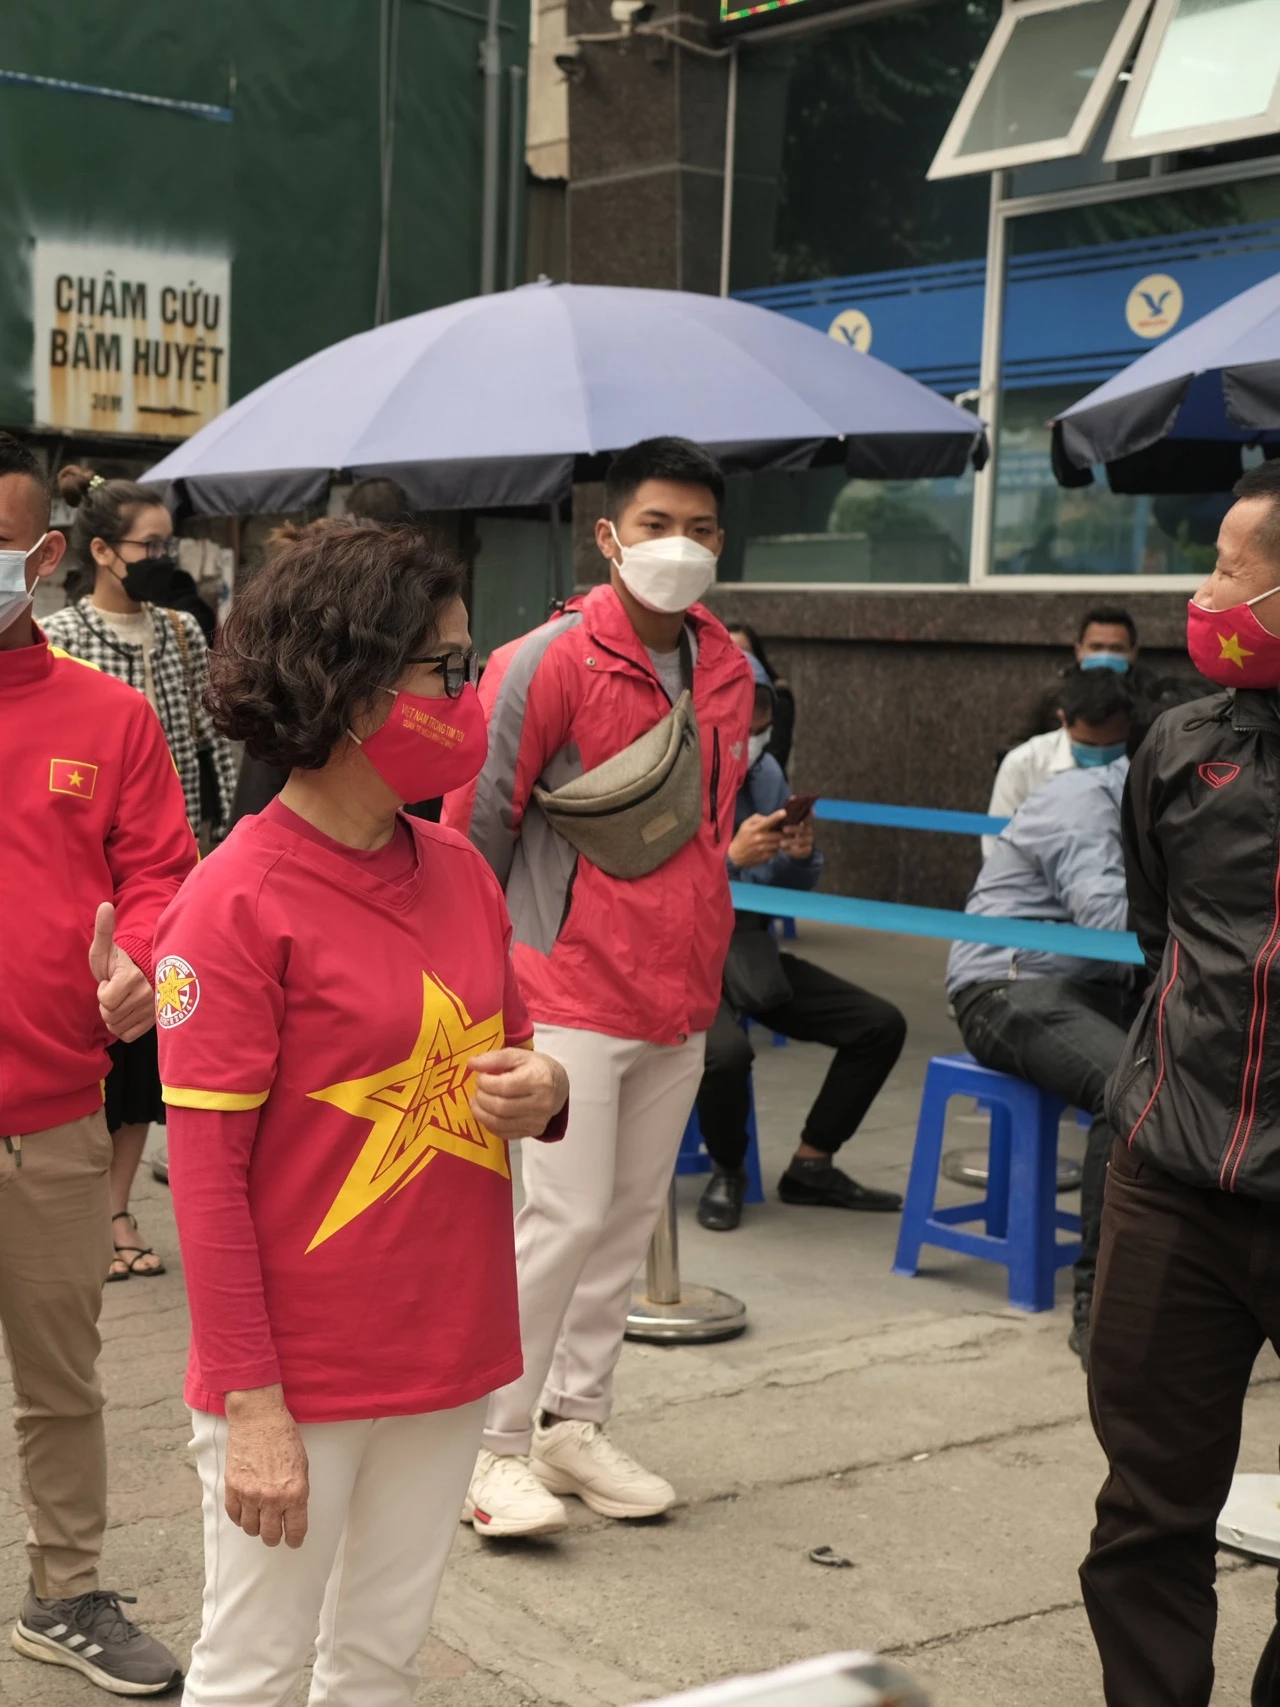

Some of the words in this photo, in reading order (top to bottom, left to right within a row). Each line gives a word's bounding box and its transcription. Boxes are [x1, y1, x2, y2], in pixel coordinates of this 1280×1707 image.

[55, 269, 148, 321] CHÂM
[160, 279, 222, 331] CỨU
[50, 322, 122, 373] BẤM
[132, 337, 224, 391] HUYỆT
